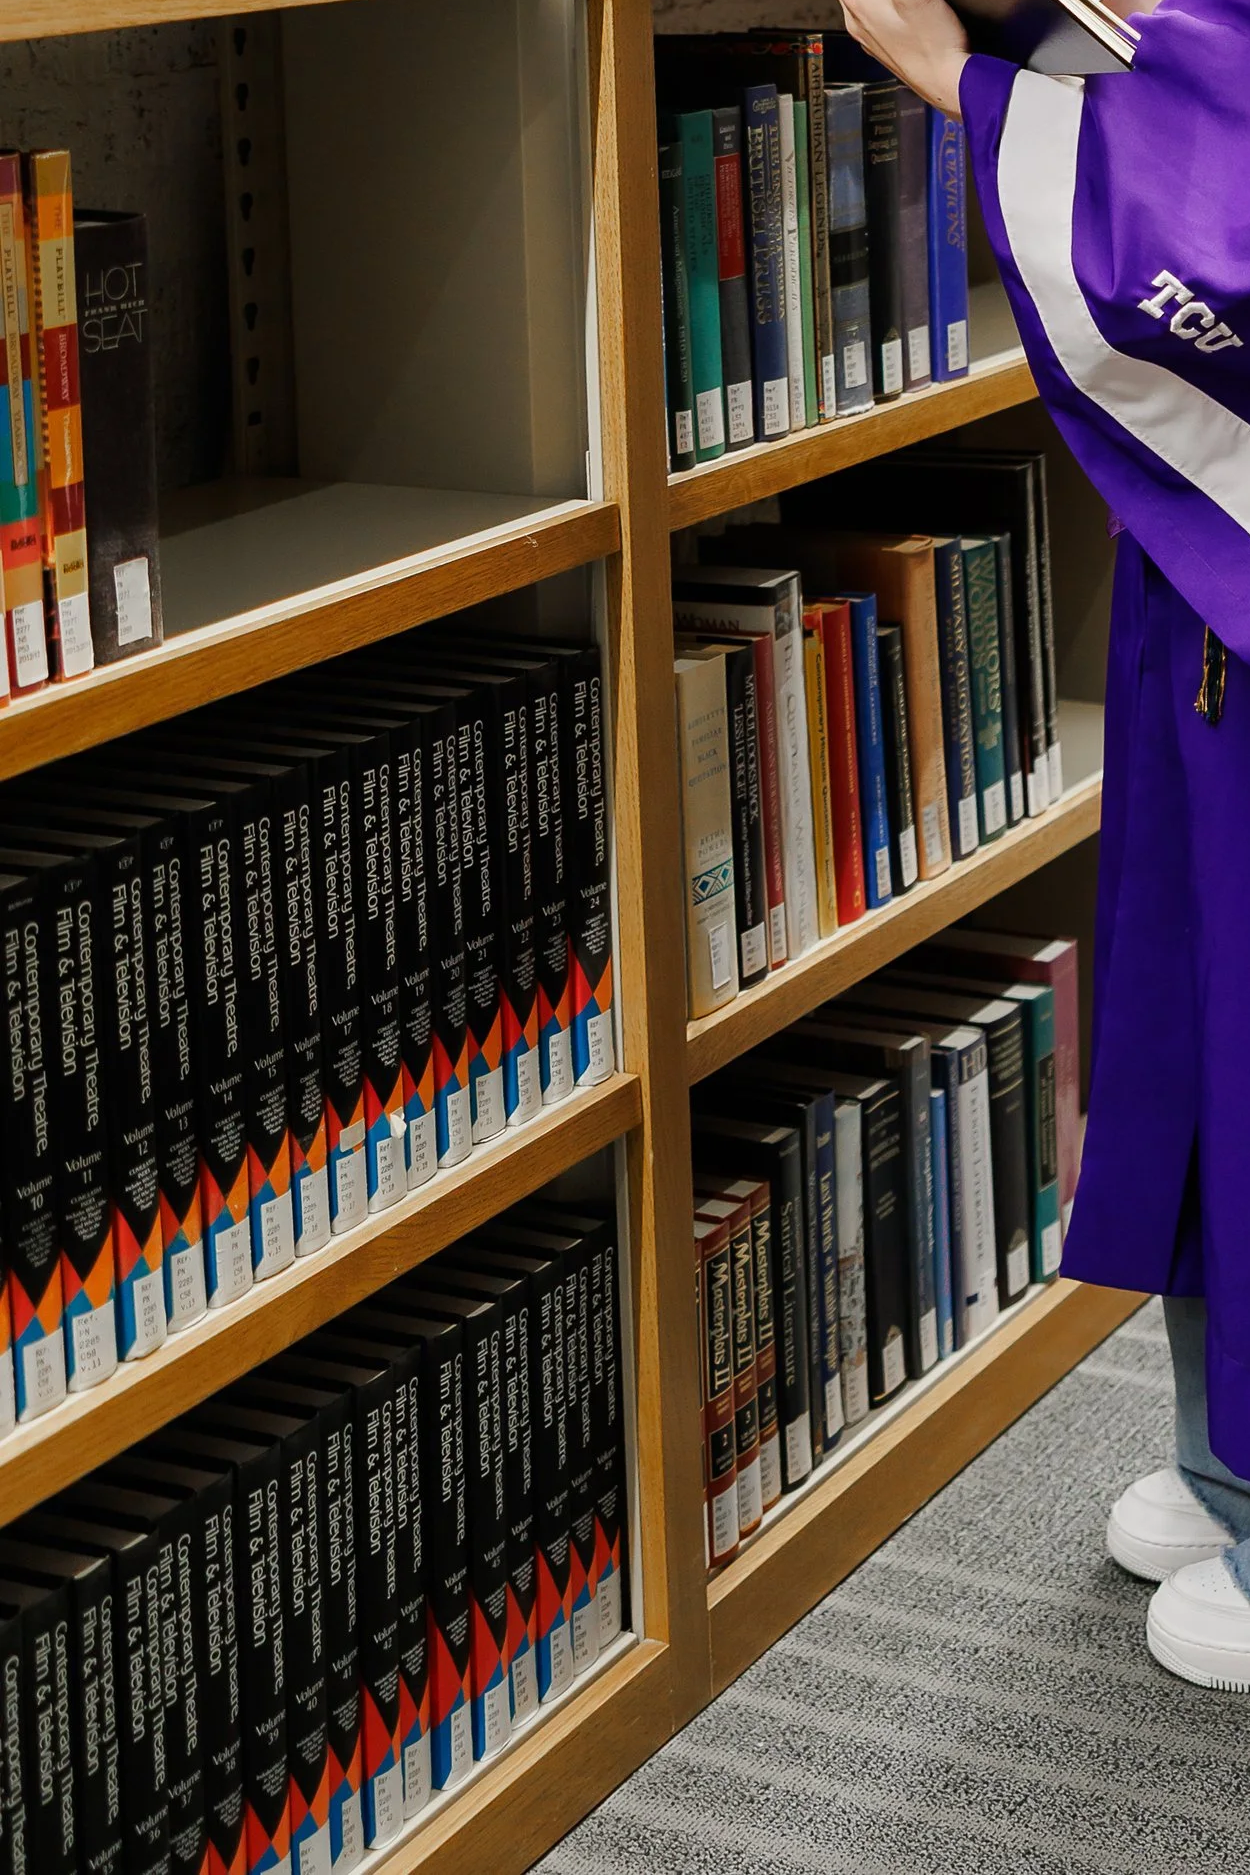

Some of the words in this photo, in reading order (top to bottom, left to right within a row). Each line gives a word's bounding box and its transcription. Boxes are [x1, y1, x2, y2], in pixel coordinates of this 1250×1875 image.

[85, 262, 143, 306] HOT
[82, 309, 148, 353] SEAT
[1137, 269, 1244, 353] TCU
[951, 552, 965, 653] MILITARY
[574, 680, 586, 718] Film
[574, 723, 587, 738] &
[589, 676, 603, 798] Contemporary
[576, 740, 589, 821] Television
[200, 844, 214, 888] Film
[202, 893, 215, 911] &
[217, 838, 234, 977] Contemporary
[580, 880, 607, 899] Volume
[590, 895, 600, 909] 24
[203, 912, 218, 1006] Television
[210, 1072, 242, 1096] Volume
[223, 1089, 233, 1105] 14
[780, 1201, 795, 1285] Satirical
[710, 1260, 729, 1367] Masterplots
[733, 1241, 752, 1348] Masterplots
[737, 1345, 752, 1368] II
[783, 1286, 796, 1387] Literature
[714, 1365, 730, 1391] II
[290, 1459, 303, 1503] Film
[290, 1507, 303, 1526] &
[305, 1450, 319, 1587] Contemporary
[291, 1526, 305, 1617] Television
[295, 1677, 325, 1705] Volume
[306, 1695, 318, 1712] 40
